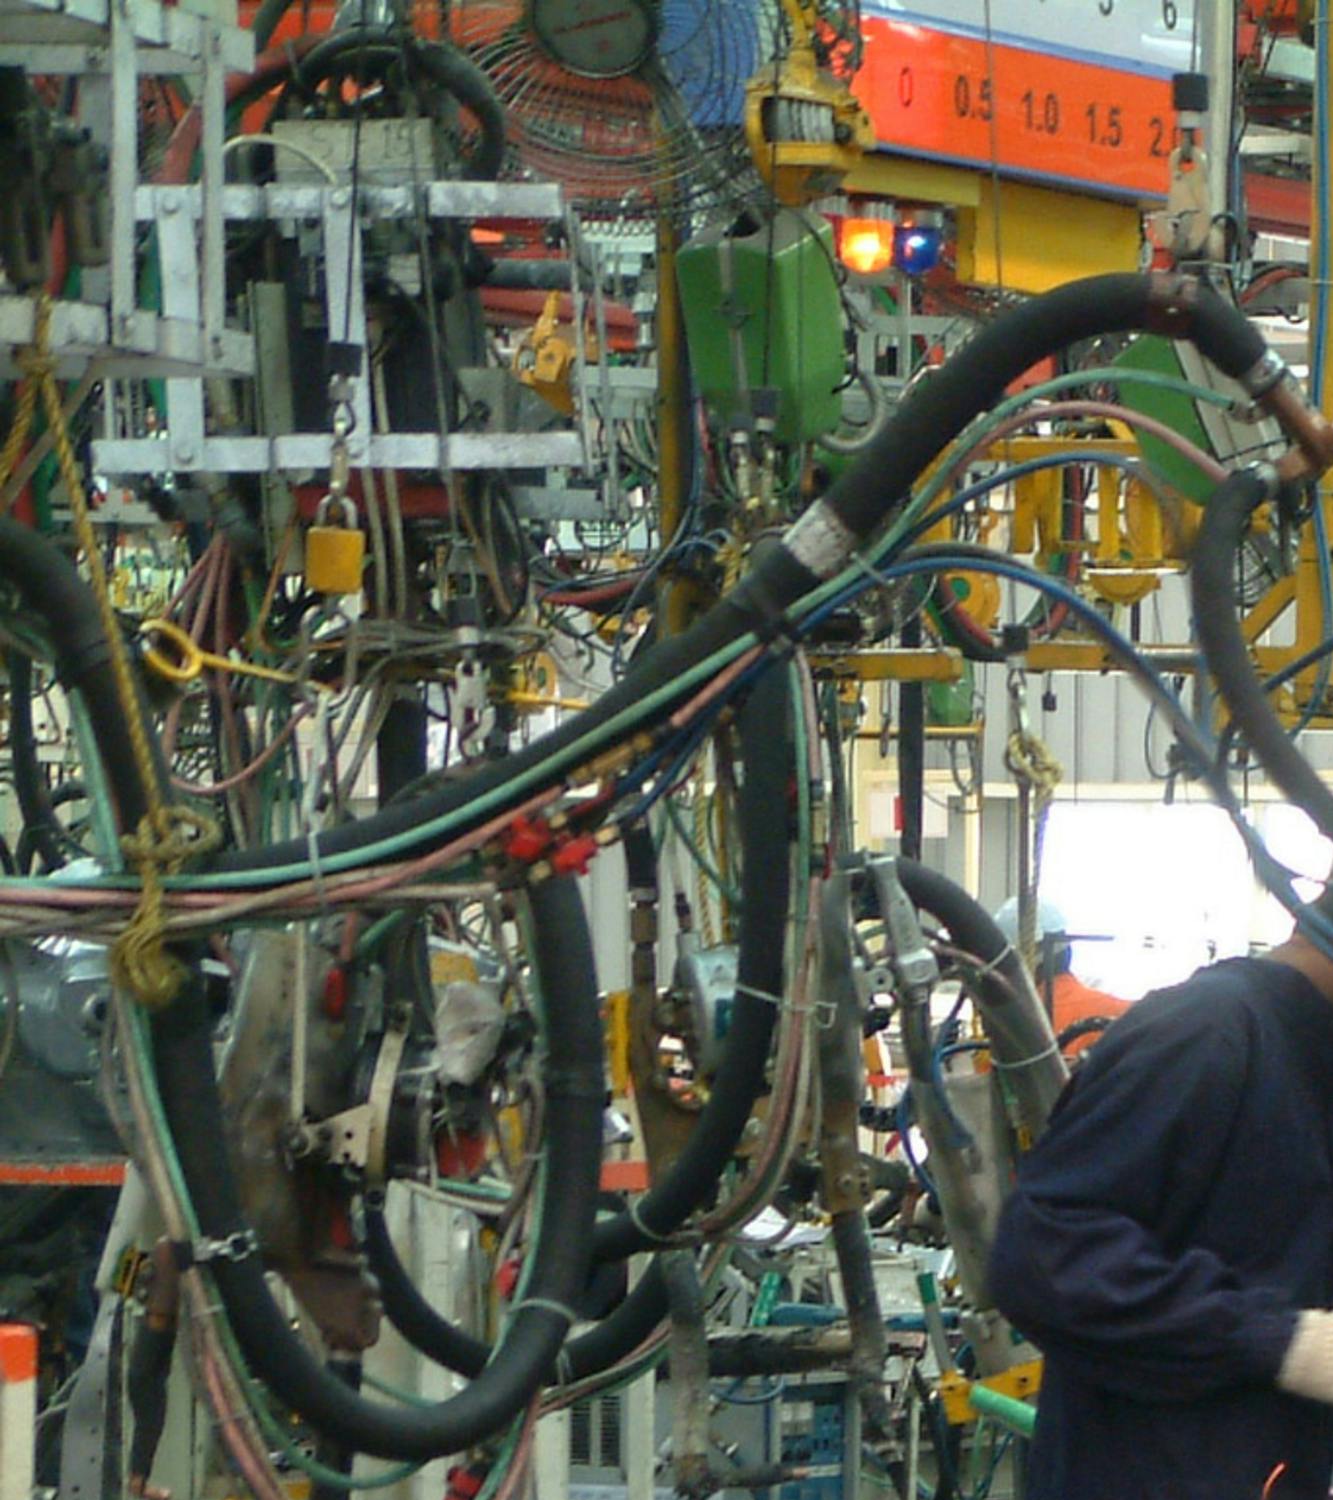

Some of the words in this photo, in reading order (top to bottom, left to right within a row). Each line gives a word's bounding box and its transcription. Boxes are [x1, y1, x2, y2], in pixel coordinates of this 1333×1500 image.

[899, 66, 913, 108] 0
[954, 74, 993, 121] 0.5
[1021, 89, 1059, 135] 1.0
[1086, 102, 1122, 147] 1.5
